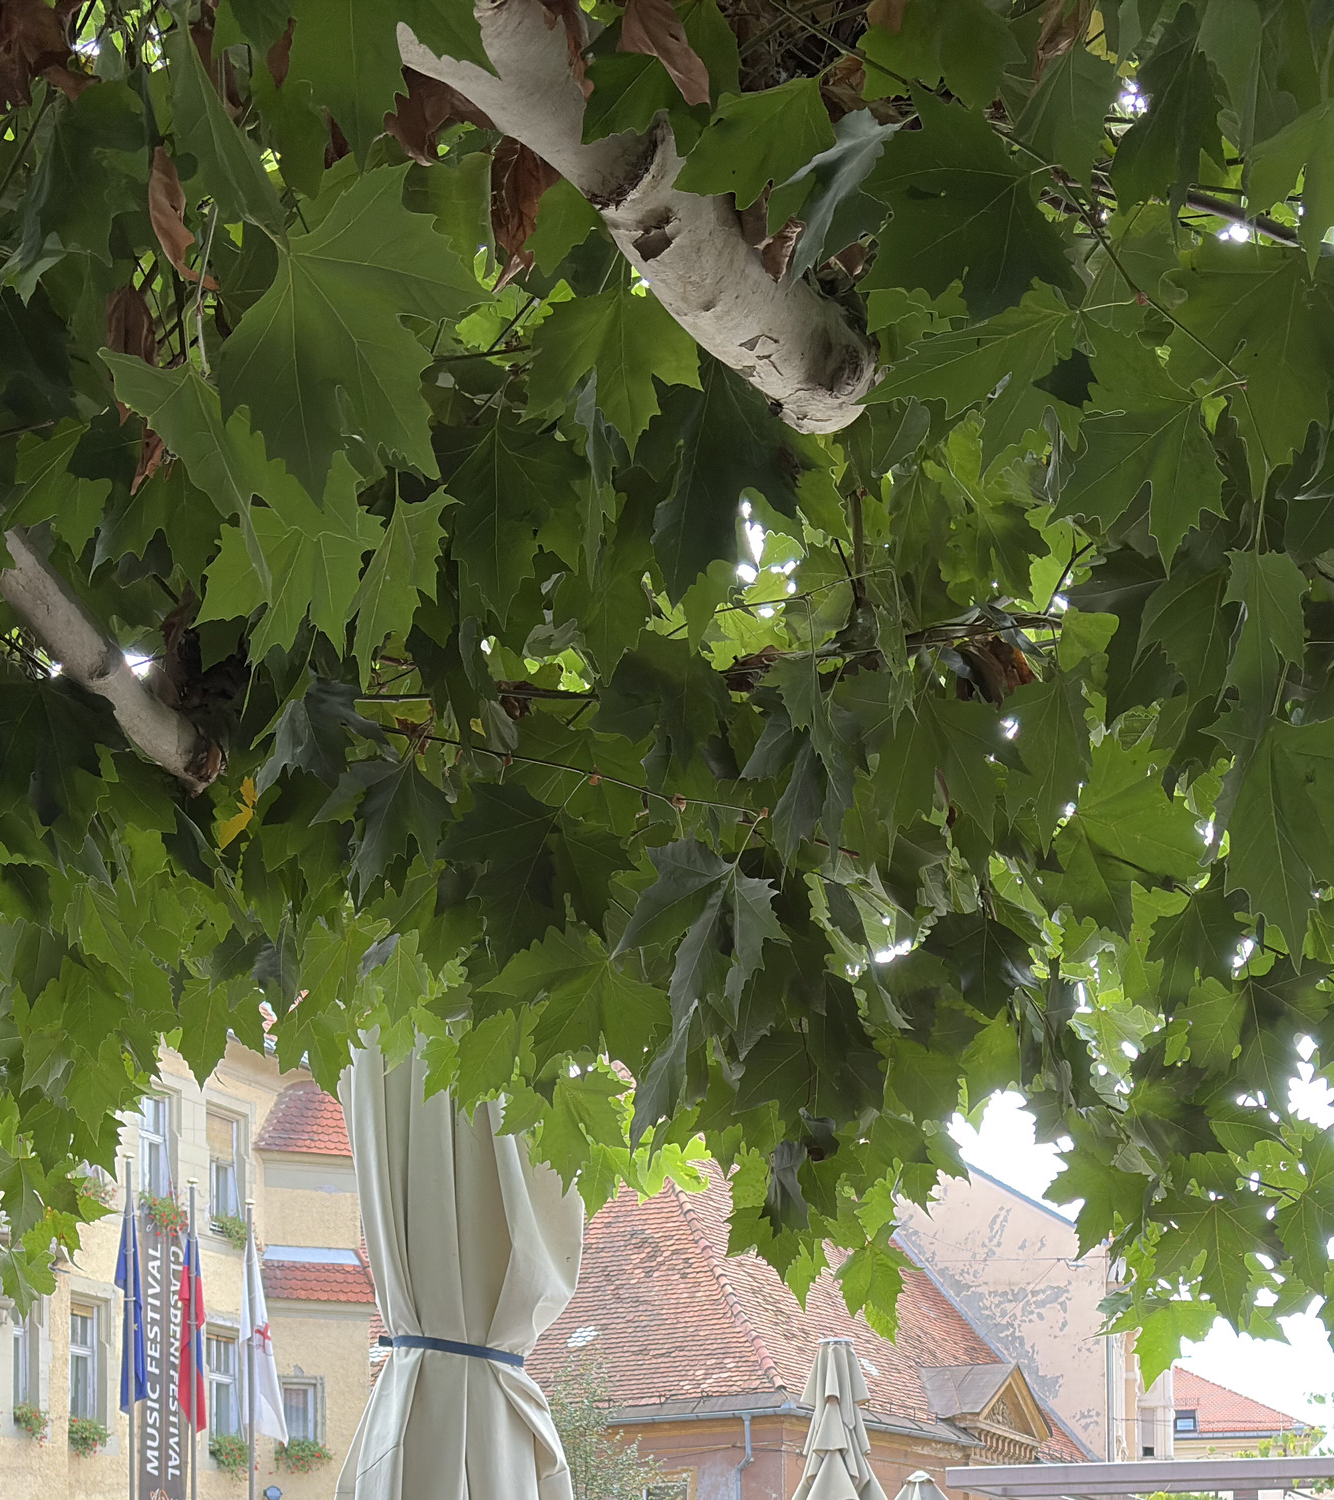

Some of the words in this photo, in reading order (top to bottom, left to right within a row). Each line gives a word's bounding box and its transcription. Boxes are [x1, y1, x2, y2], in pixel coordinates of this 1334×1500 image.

[147, 1243, 161, 1376] FESTIVAL
[169, 1245, 184, 1365] GLASBENI
[146, 1383, 160, 1477] MUSIC
[167, 1367, 181, 1481] FESTIVAL
